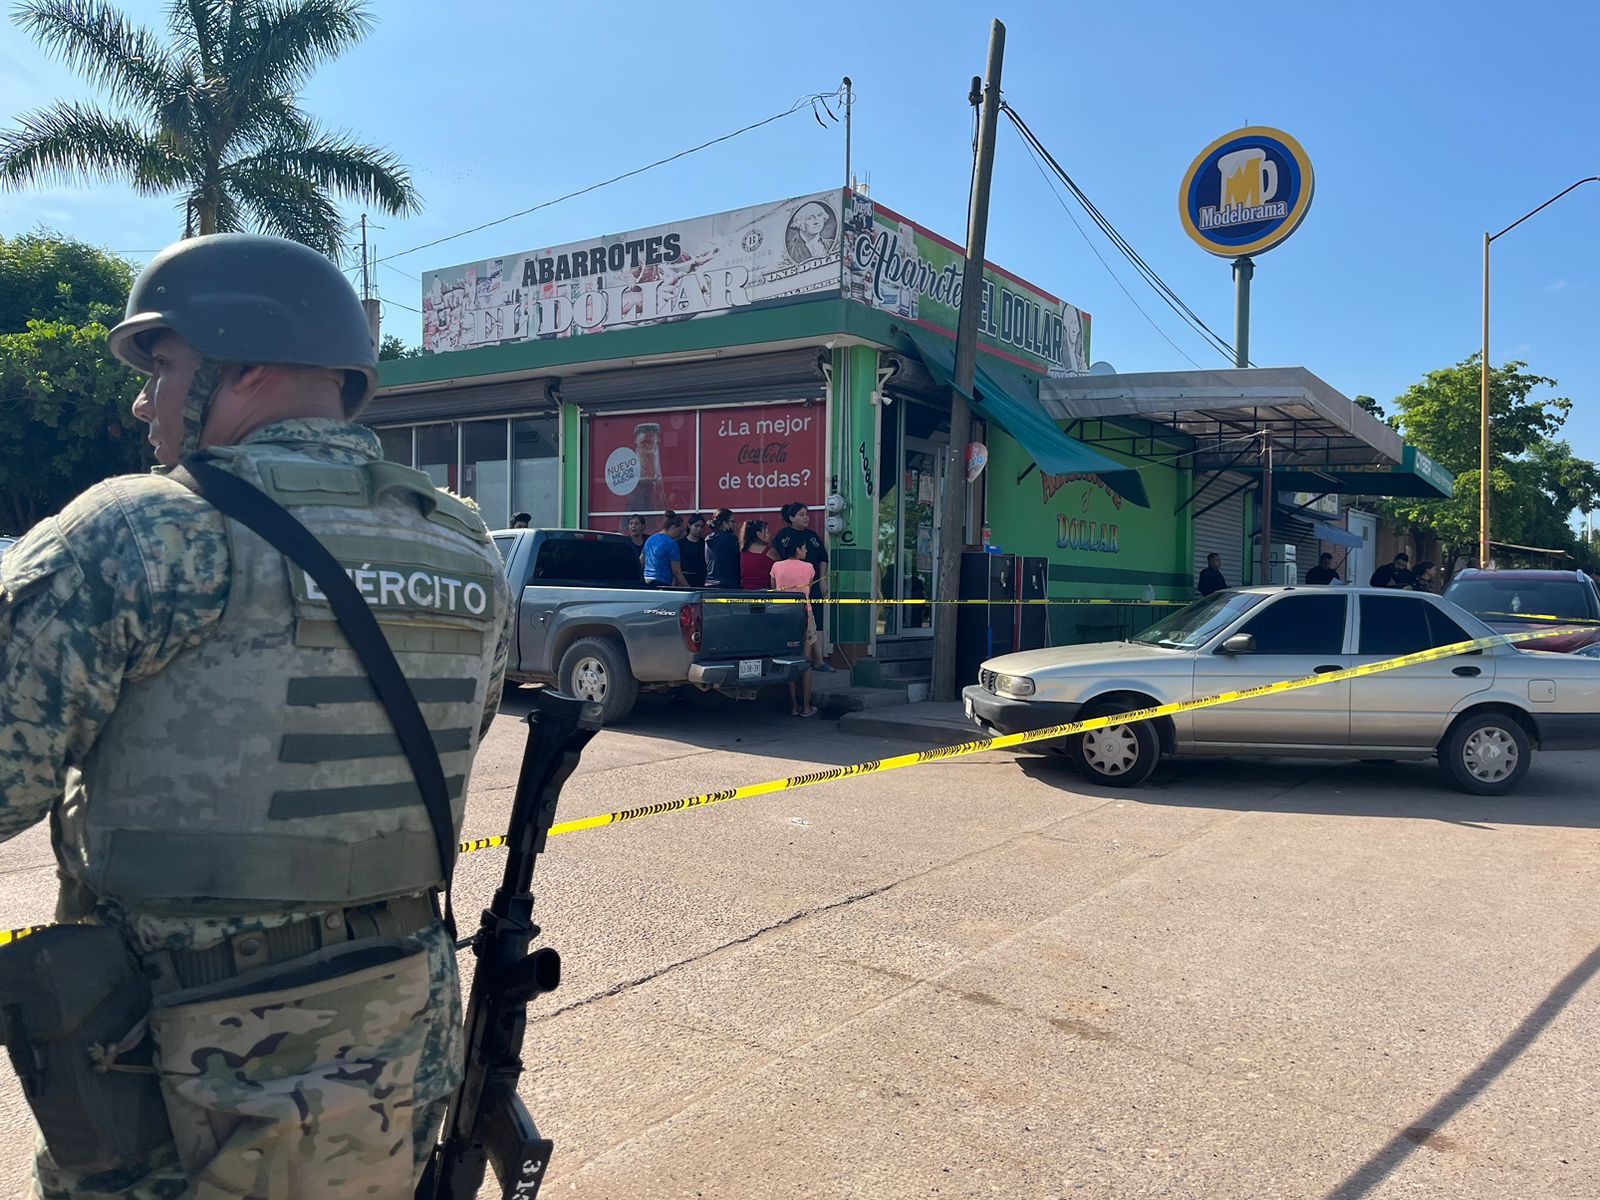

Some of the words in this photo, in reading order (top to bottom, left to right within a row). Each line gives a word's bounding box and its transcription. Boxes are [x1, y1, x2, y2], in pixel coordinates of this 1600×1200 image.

[1201, 202, 1286, 228] Modelorama
[522, 233, 682, 287] ABARROTES
[856, 231, 963, 308] Abarrote
[469, 303, 529, 345] EL
[535, 264, 752, 336] DOLLAR
[978, 279, 998, 338] EL
[1000, 288, 1064, 366] DOLLAR
[718, 419, 750, 437] ¿La
[756, 414, 812, 437] mejor
[607, 457, 637, 476] NUEVO
[718, 472, 741, 489] de
[747, 469, 811, 488] todas?
[860, 441, 873, 496] 4080
[1056, 513, 1121, 554] DOLLAR
[303, 562, 487, 616] EÉRCITO
